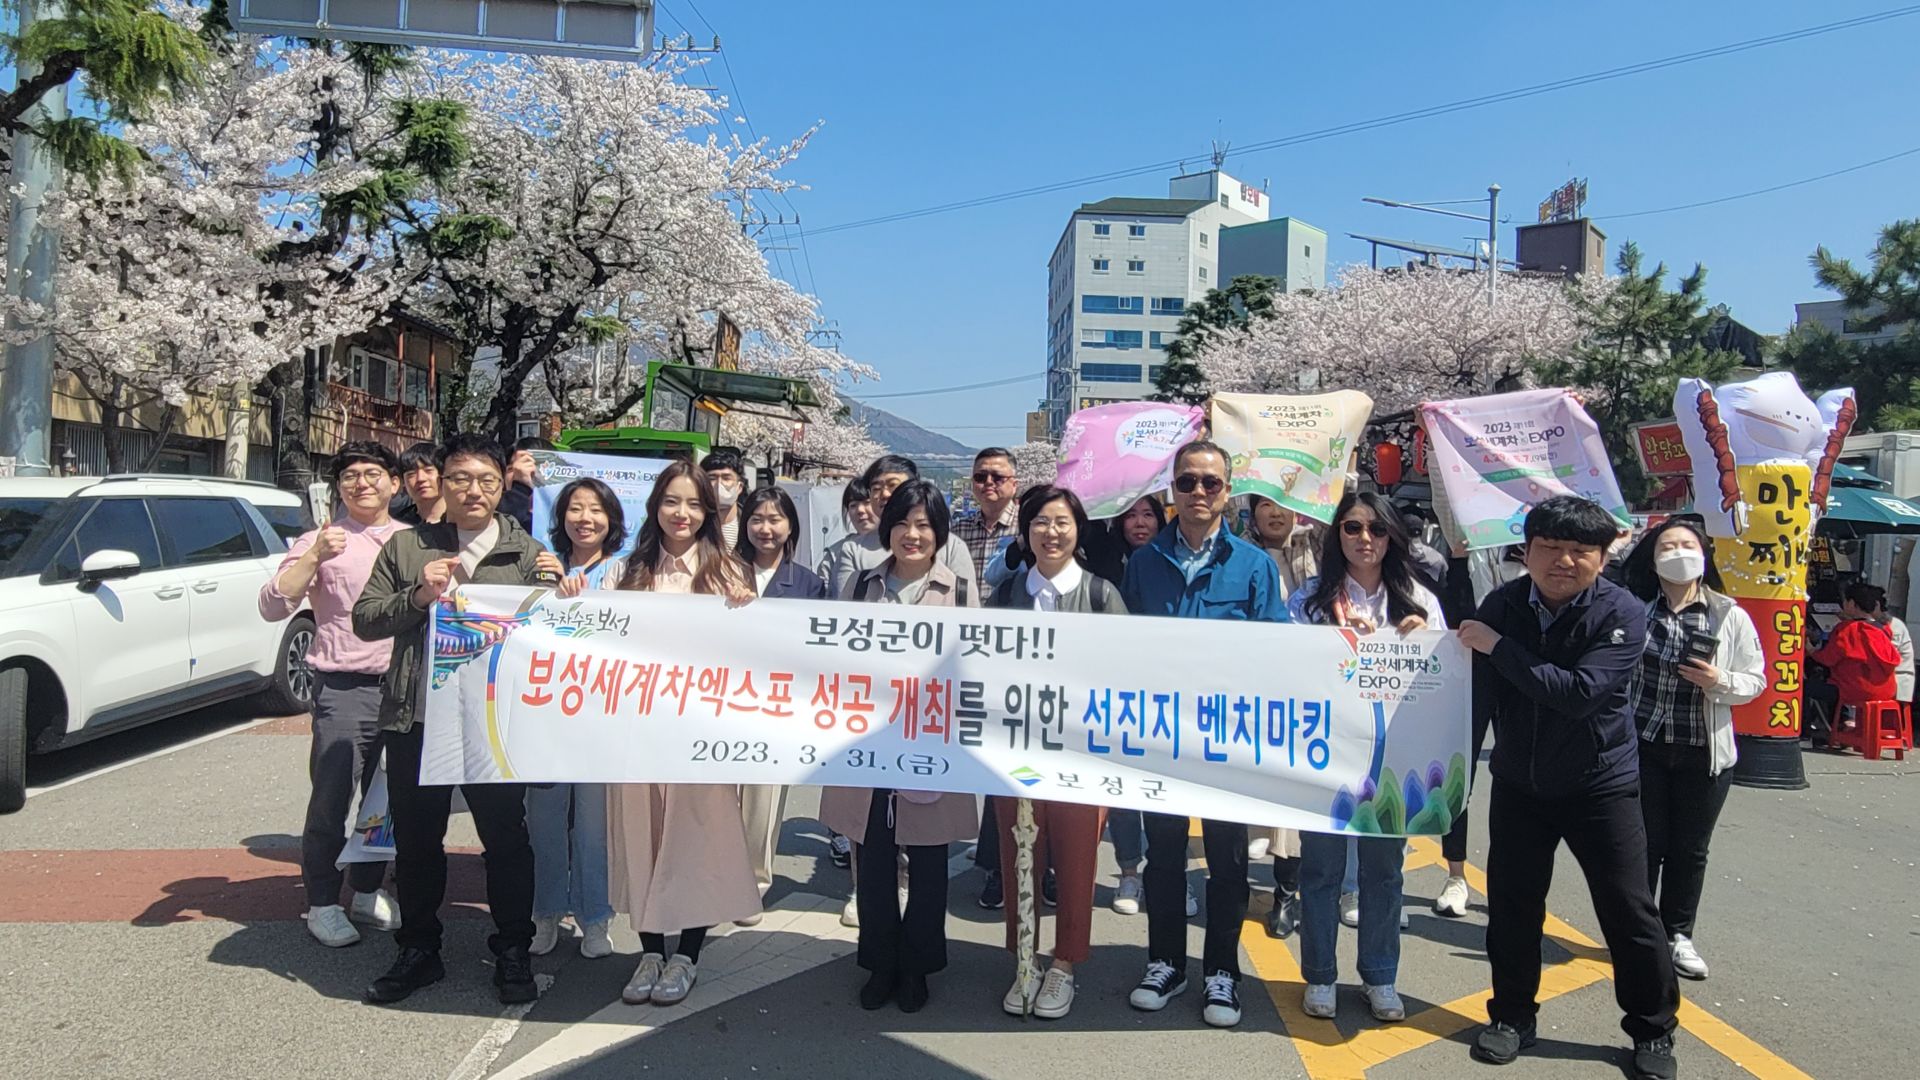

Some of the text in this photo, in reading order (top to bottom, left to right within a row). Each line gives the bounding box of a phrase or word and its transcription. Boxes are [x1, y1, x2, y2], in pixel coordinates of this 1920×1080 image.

[1135, 420, 1158, 428] 2023
[1277, 420, 1317, 428] EXPO
[1483, 421, 1512, 434] 2023
[1528, 426, 1565, 443] EXPO
[1645, 435, 1687, 465] 왕닭꼬
[556, 467, 577, 476] 2023
[542, 607, 631, 637] 녹차수도 보성
[805, 616, 1056, 660] 보성군이 떳다!!
[1359, 642, 1421, 656] 2023 제11회
[1359, 656, 1430, 674] 보성세계차
[1768, 604, 1805, 732] 닭꼬치
[1358, 674, 1401, 690] EXPO
[520, 650, 1331, 771] 보성세계차엑스포 성공 개최를 위한 선진지 벤치마킹
[691, 739, 779, 765] 2023.
[799, 744, 827, 767] 3.
